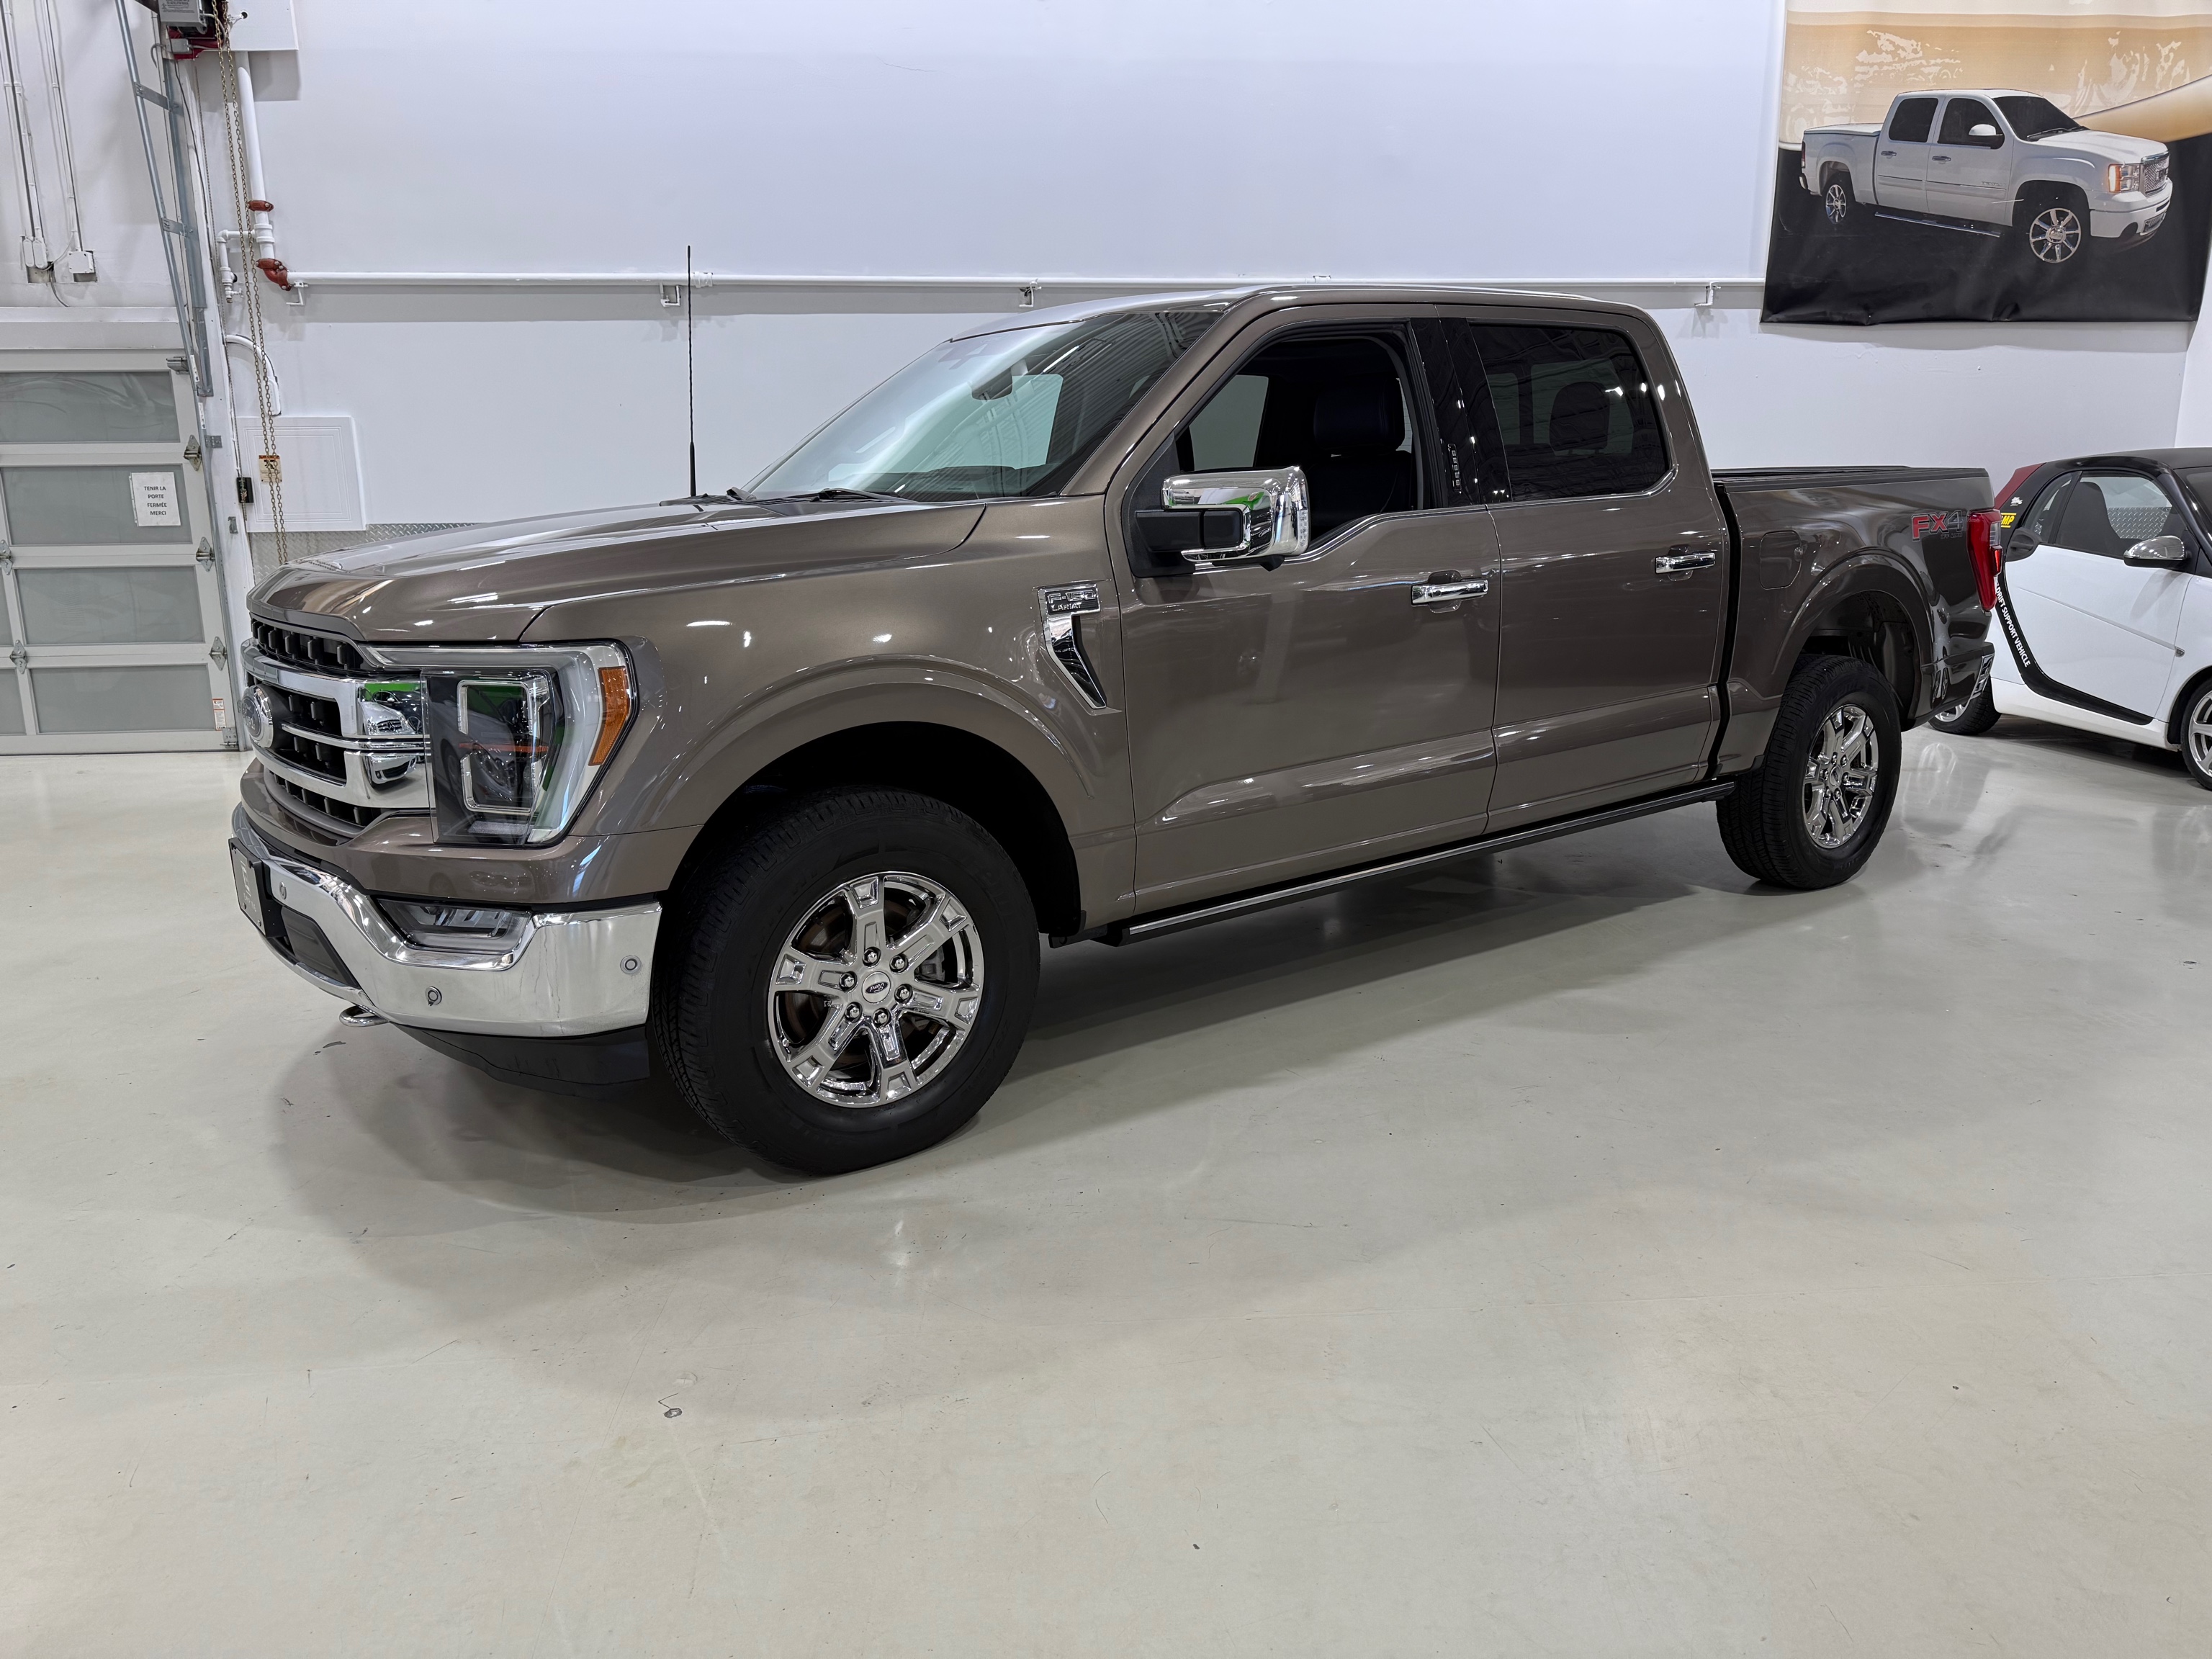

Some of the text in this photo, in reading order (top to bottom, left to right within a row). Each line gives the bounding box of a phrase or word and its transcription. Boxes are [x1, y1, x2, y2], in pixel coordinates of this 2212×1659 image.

[1912, 510, 1964, 541] FX4
[1047, 589, 1096, 604] F-150
[1051, 601, 1082, 611] LARIAT
[1996, 586, 2031, 667] DRIFT SUPPORT VEHICLE
[869, 982, 885, 992] Ford
